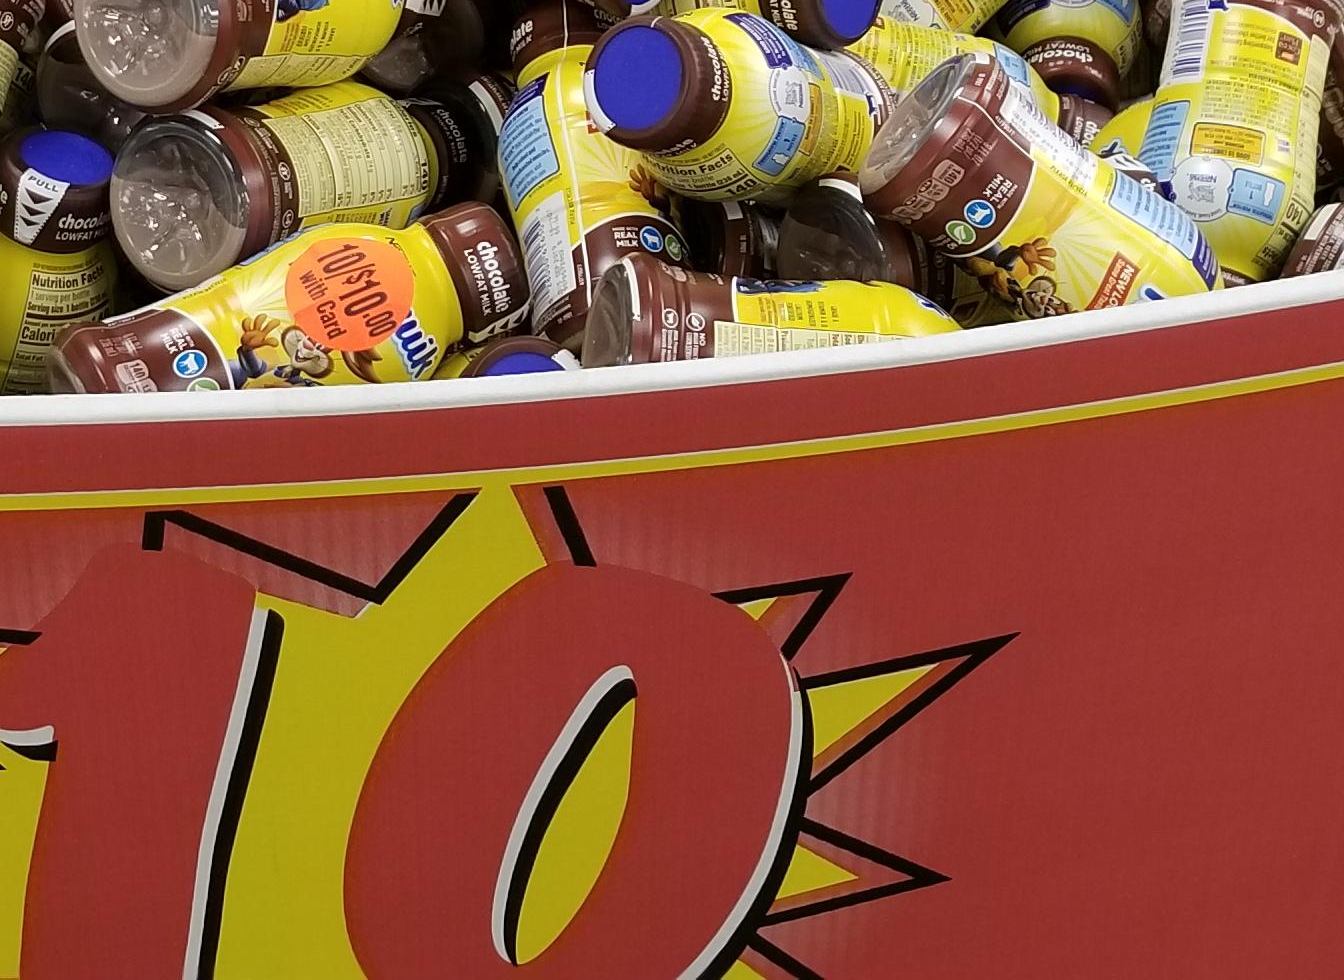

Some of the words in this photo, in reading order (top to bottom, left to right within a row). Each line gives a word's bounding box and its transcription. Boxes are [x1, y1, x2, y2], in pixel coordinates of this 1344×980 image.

[436, 108, 468, 164] chocolate
[704, 153, 734, 172] Facts
[28, 175, 59, 194] PULL
[725, 179, 757, 196] 140
[982, 173, 1002, 198] MILK
[989, 178, 1014, 203] REAL
[1285, 202, 1302, 226] 140
[56, 231, 94, 242] LOWFAT
[613, 231, 638, 240] REAL
[615, 239, 639, 248] MILK
[32, 273, 79, 289] Nutrition
[80, 265, 105, 287] Facts
[463, 248, 488, 293] LOWFAT
[478, 291, 492, 317] MILK
[476, 240, 512, 314] chocolate
[316, 243, 398, 338] 10/$10.00
[298, 269, 328, 300] with
[315, 299, 348, 341] Card
